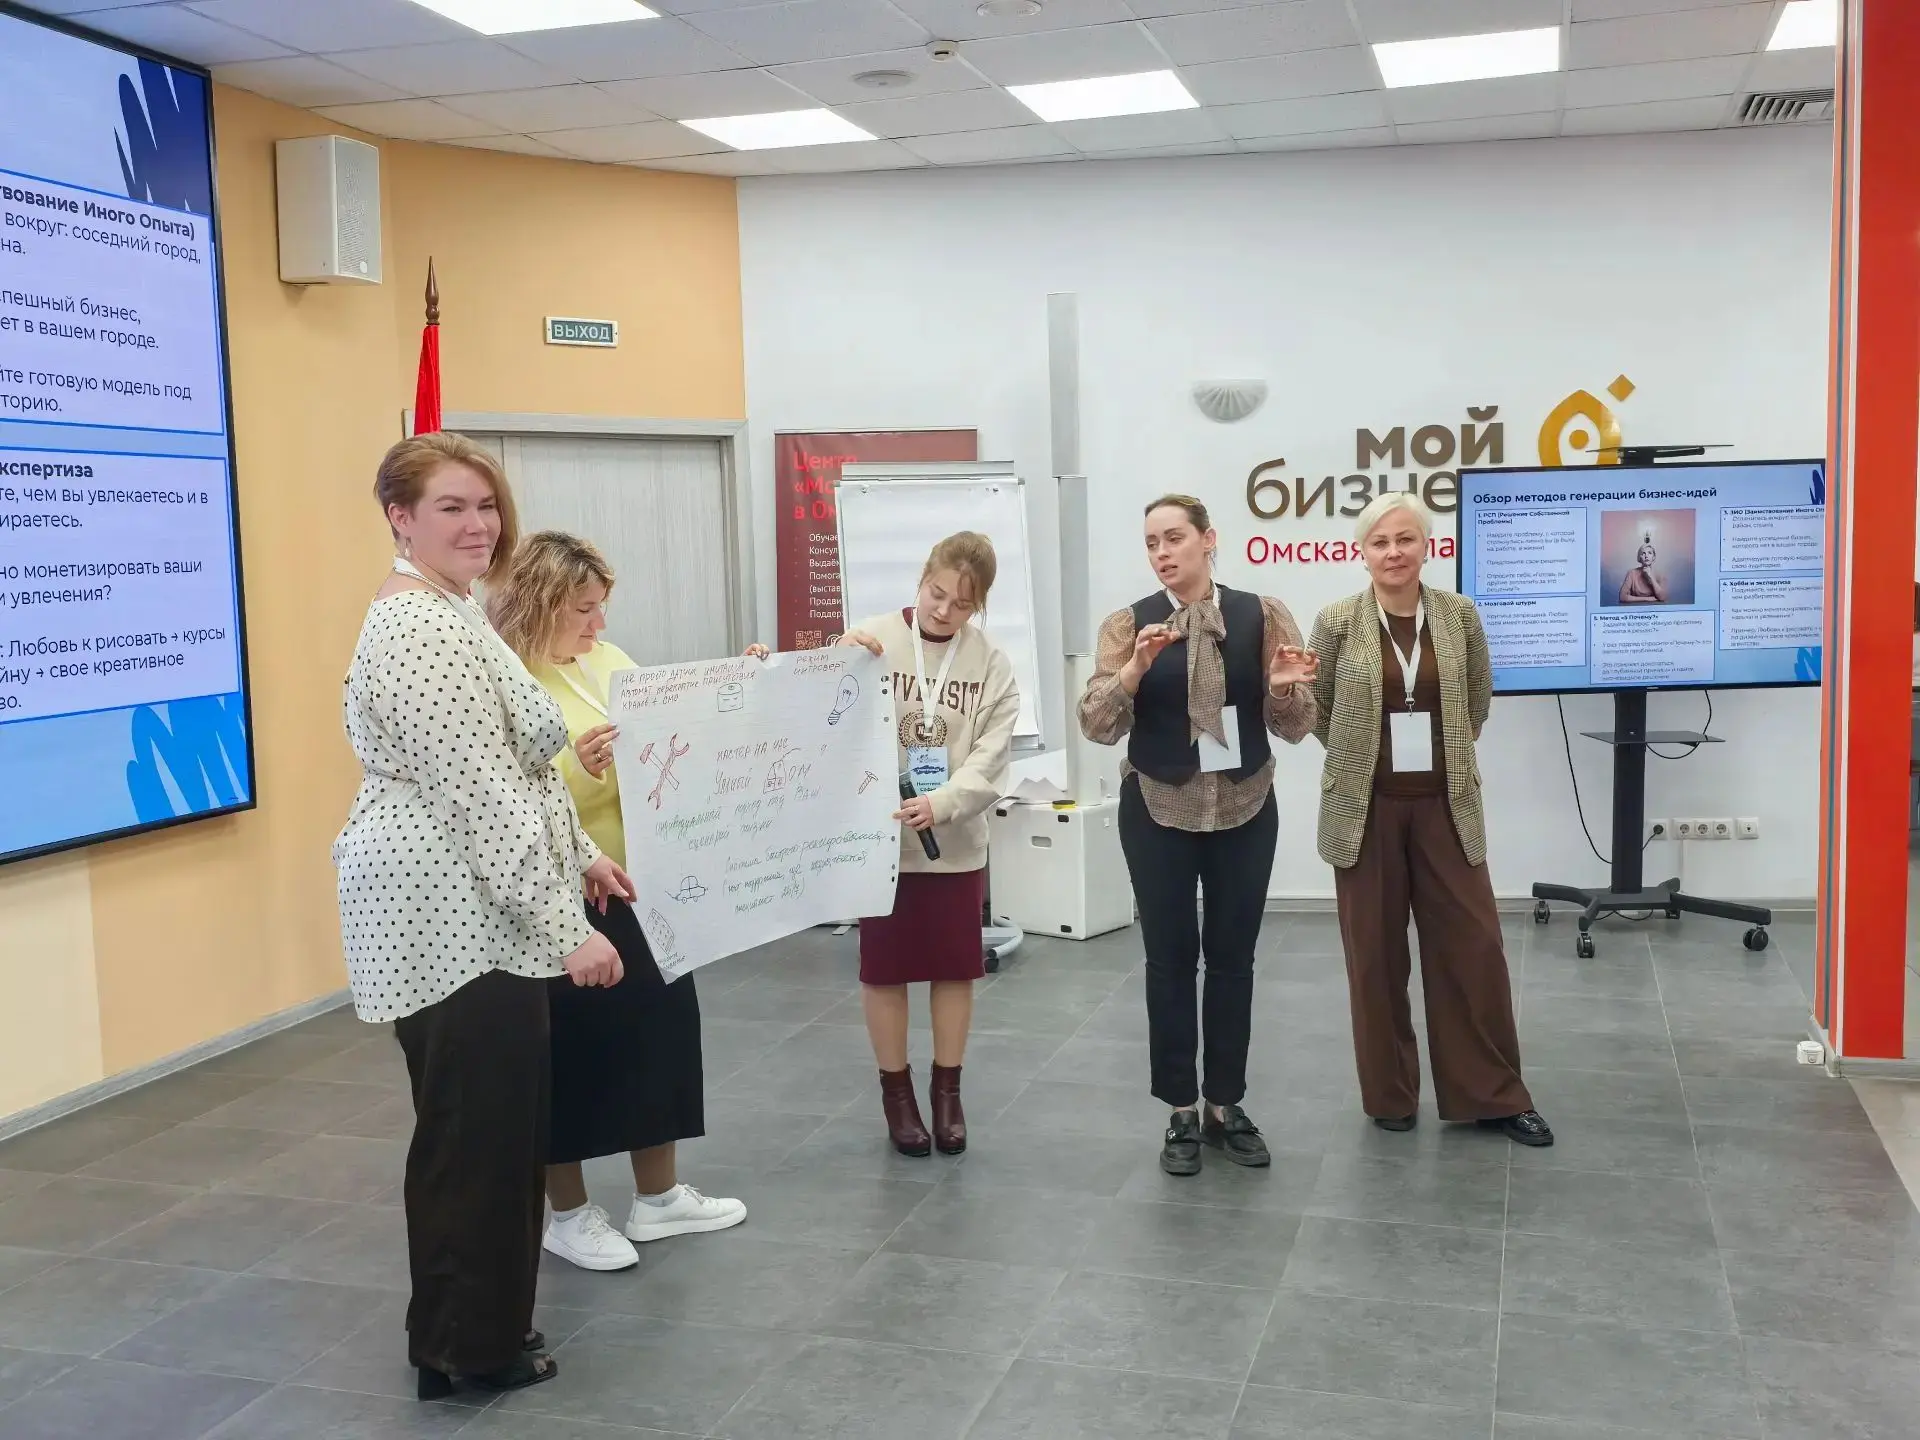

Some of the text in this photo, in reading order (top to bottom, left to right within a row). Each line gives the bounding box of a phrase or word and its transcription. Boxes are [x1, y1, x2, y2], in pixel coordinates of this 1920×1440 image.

[0, 186, 196, 241] вование Иного Опыта)
[1, 238, 26, 254] на.
[5, 212, 201, 264] вокруг: соседний город,
[0, 289, 141, 324] пешный бизнес,
[0, 316, 160, 349] ет в вашем городе.
[554, 324, 610, 341] ВЫХОД
[29, 371, 98, 392] готовую
[102, 380, 160, 397] модель
[164, 384, 192, 401] под
[0, 394, 63, 413] торию.
[0, 461, 94, 480] кспертиза
[794, 475, 836, 495] «Мо
[1246, 457, 1457, 519] бизне
[0, 488, 208, 508] те, чем вы увлекаетесь и в
[1473, 487, 1717, 504] Обзор методов генерации бизнес-идей
[793, 505, 806, 519] в
[0, 514, 83, 531] ираетесь.
[809, 533, 839, 544] Обучае
[809, 546, 838, 556] Консул
[1247, 536, 1365, 564] Омская
[0, 559, 202, 579] но монетизировать ваши
[809, 571, 841, 580] Помога
[11, 584, 112, 609] увлечения?
[809, 584, 841, 594] (выстав
[809, 597, 842, 606] Продви
[809, 609, 843, 619] Поддер
[9, 627, 225, 657] Любовь к рисовать курсы
[0, 652, 184, 685] йну свое креативное
[0, 696, 21, 709] во.
